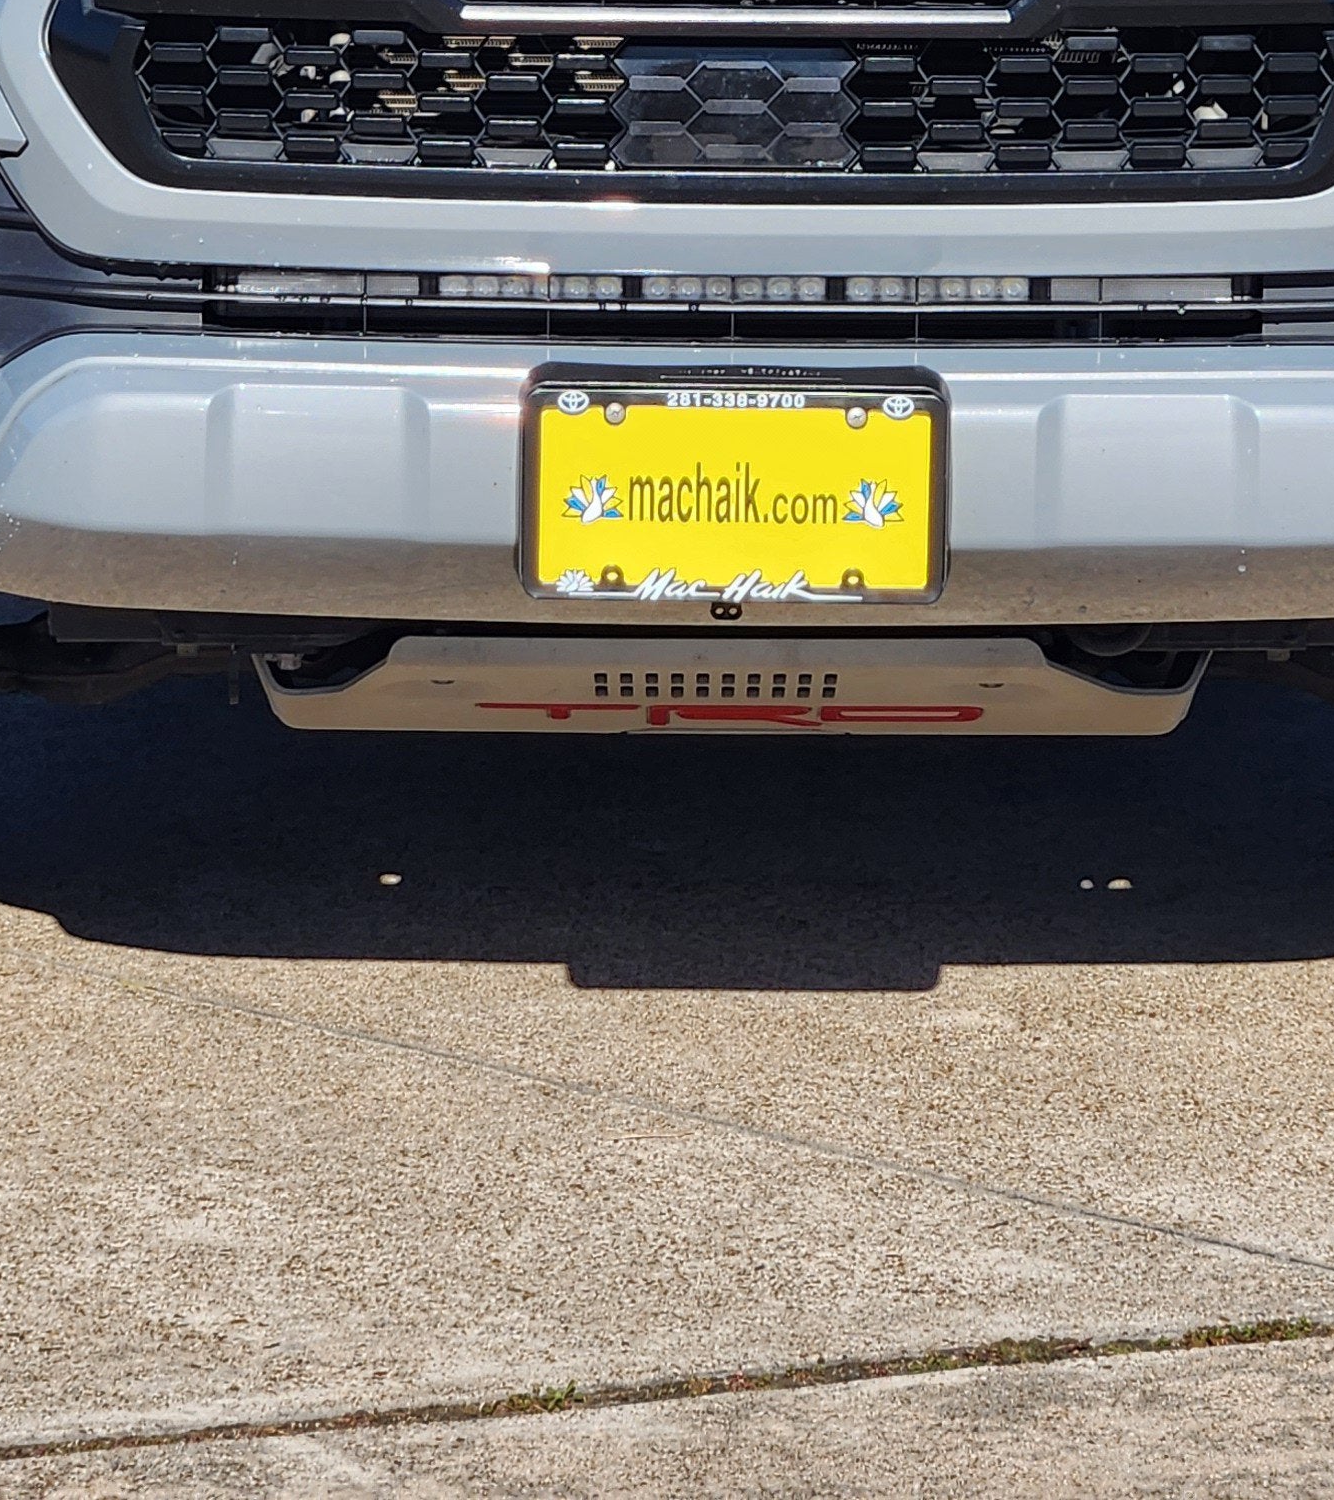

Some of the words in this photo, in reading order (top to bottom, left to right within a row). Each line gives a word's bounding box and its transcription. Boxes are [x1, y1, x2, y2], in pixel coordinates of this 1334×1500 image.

[667, 391, 806, 408] 281-338-9700
[628, 462, 839, 525] machaik.com
[632, 567, 722, 602] Mac
[722, 568, 812, 601] Haik
[478, 702, 985, 726] TRD
